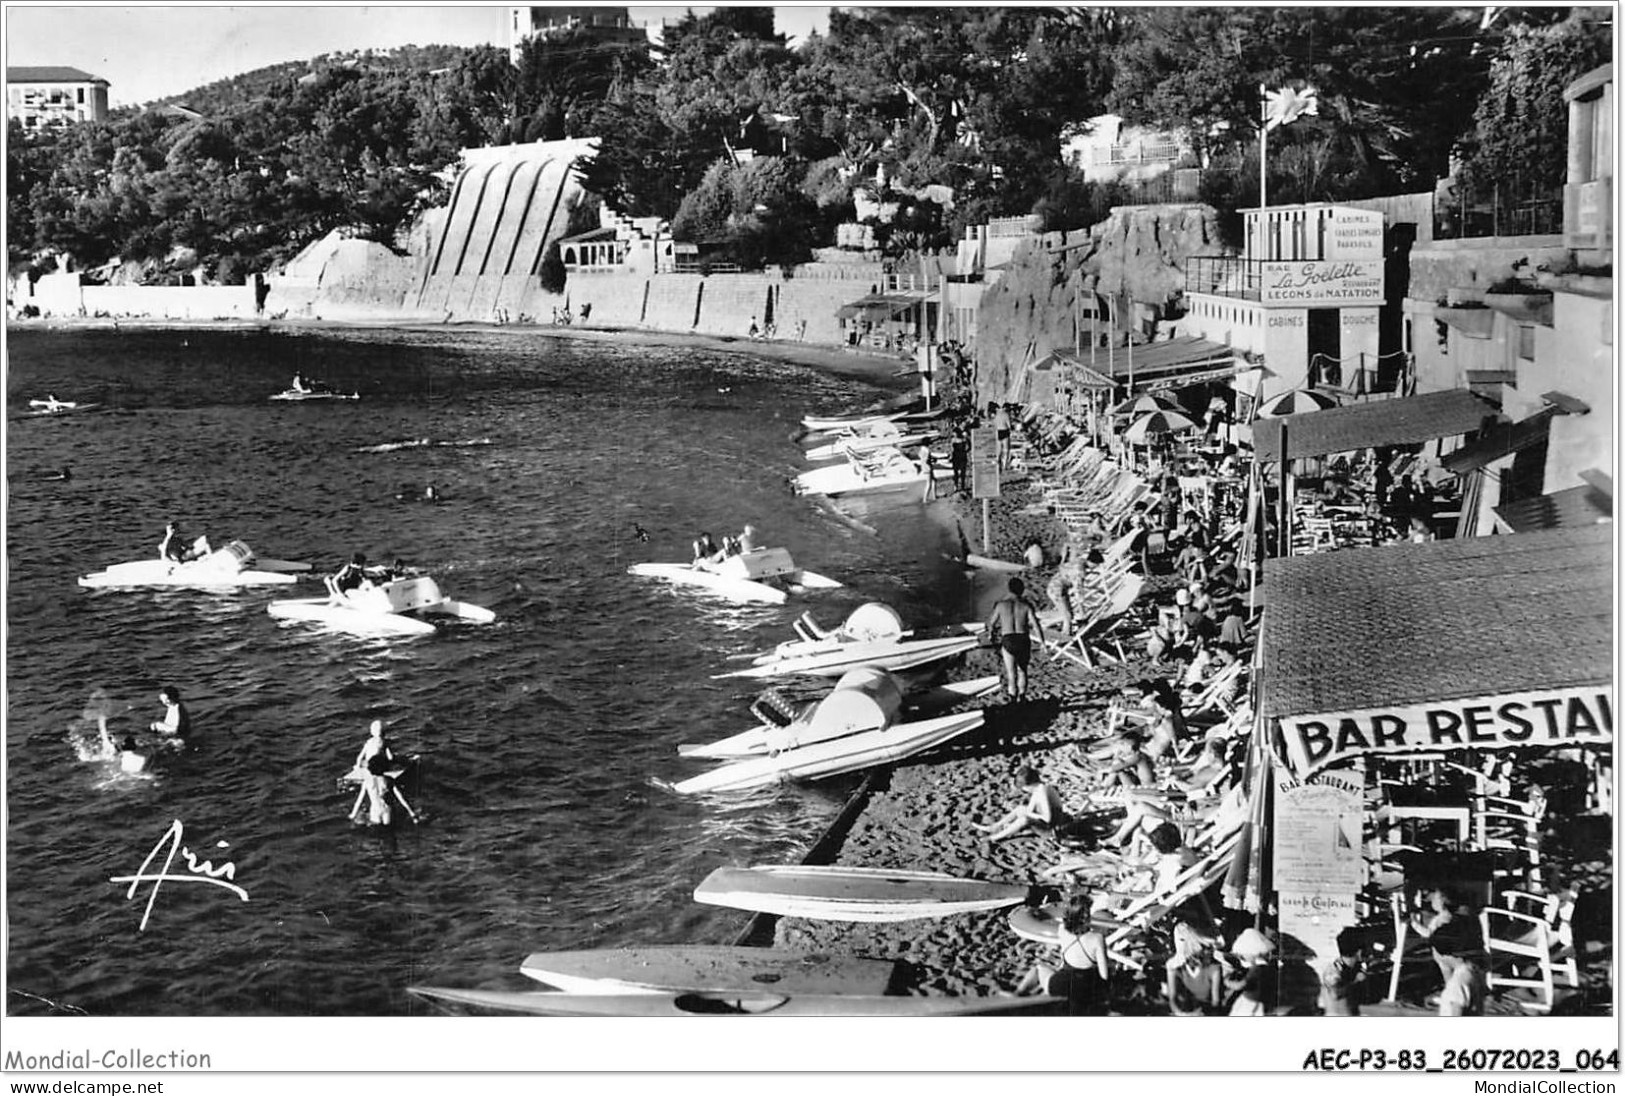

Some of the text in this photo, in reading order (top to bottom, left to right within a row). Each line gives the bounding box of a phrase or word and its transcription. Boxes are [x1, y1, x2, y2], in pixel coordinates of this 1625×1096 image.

[1271, 273, 1293, 289] La
[1326, 289, 1380, 298] NATATION
[1269, 315, 1377, 327] CABINES DOUCHE
[1305, 775, 1361, 796] STAURANT
